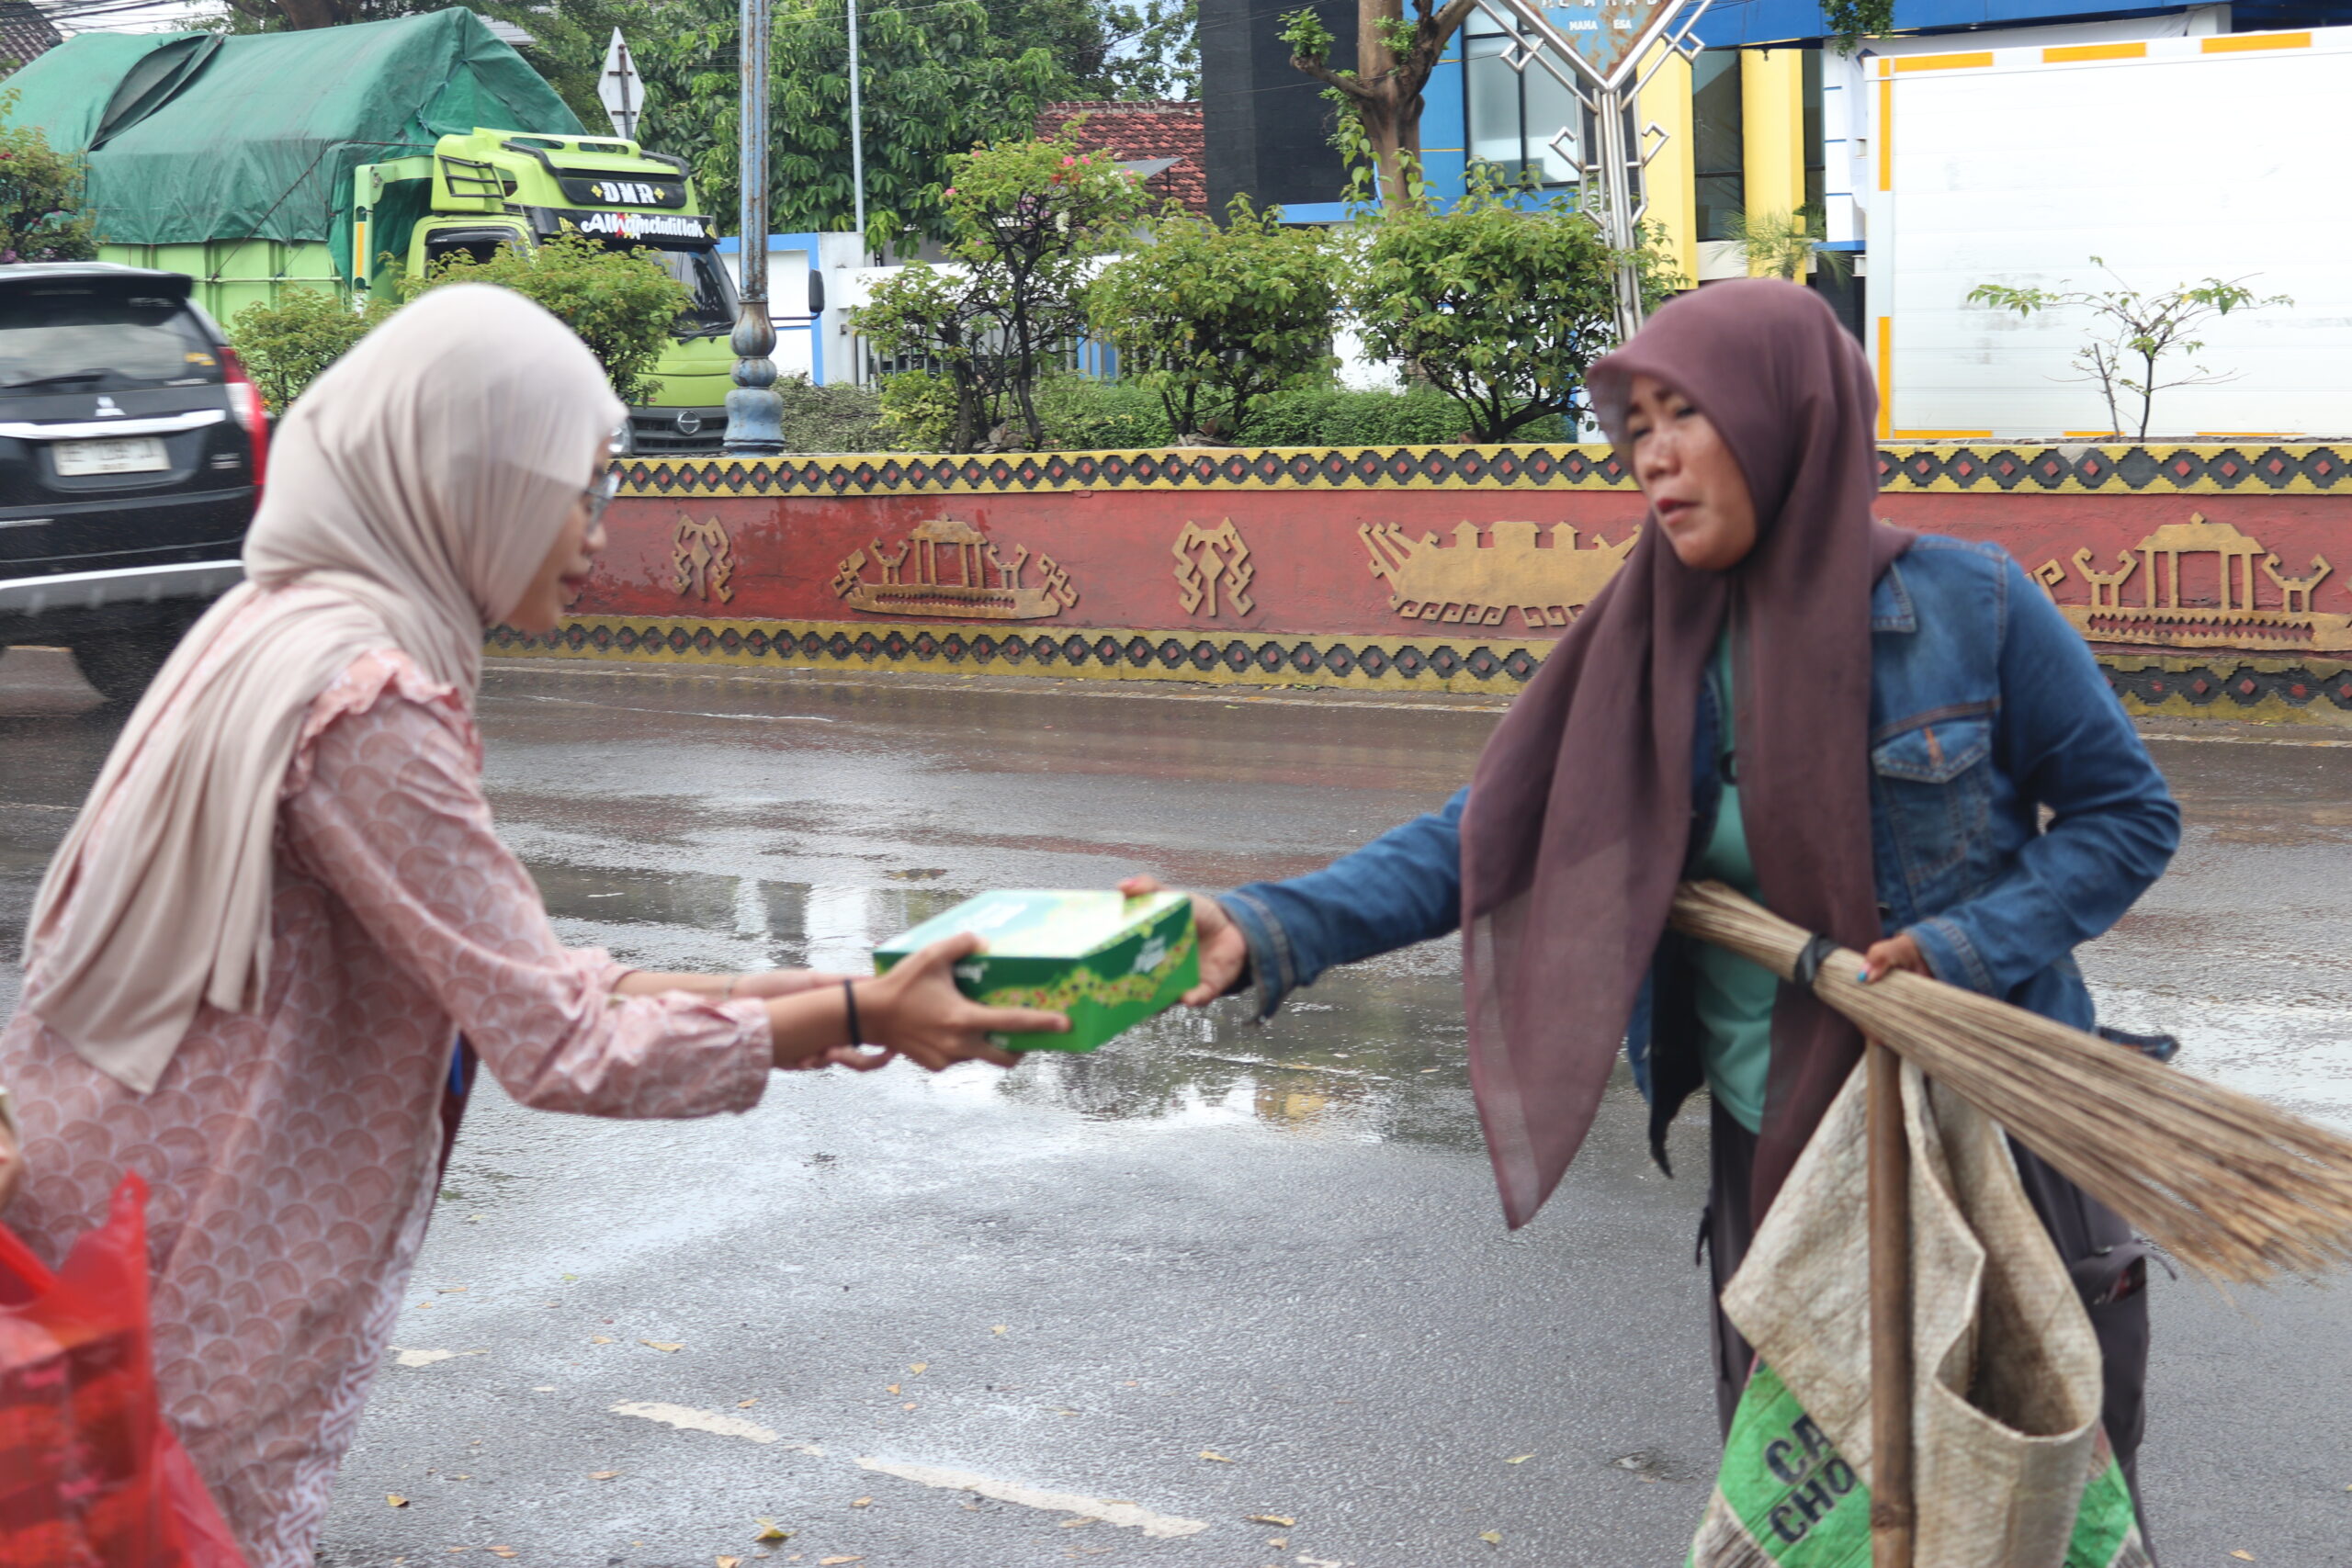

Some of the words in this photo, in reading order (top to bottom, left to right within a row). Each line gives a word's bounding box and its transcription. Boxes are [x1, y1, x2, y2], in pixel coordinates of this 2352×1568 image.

[1569, 20, 1598, 30] MAHA
[1613, 19, 1632, 29] ESA
[581, 212, 706, 239] Alhamdulillah
